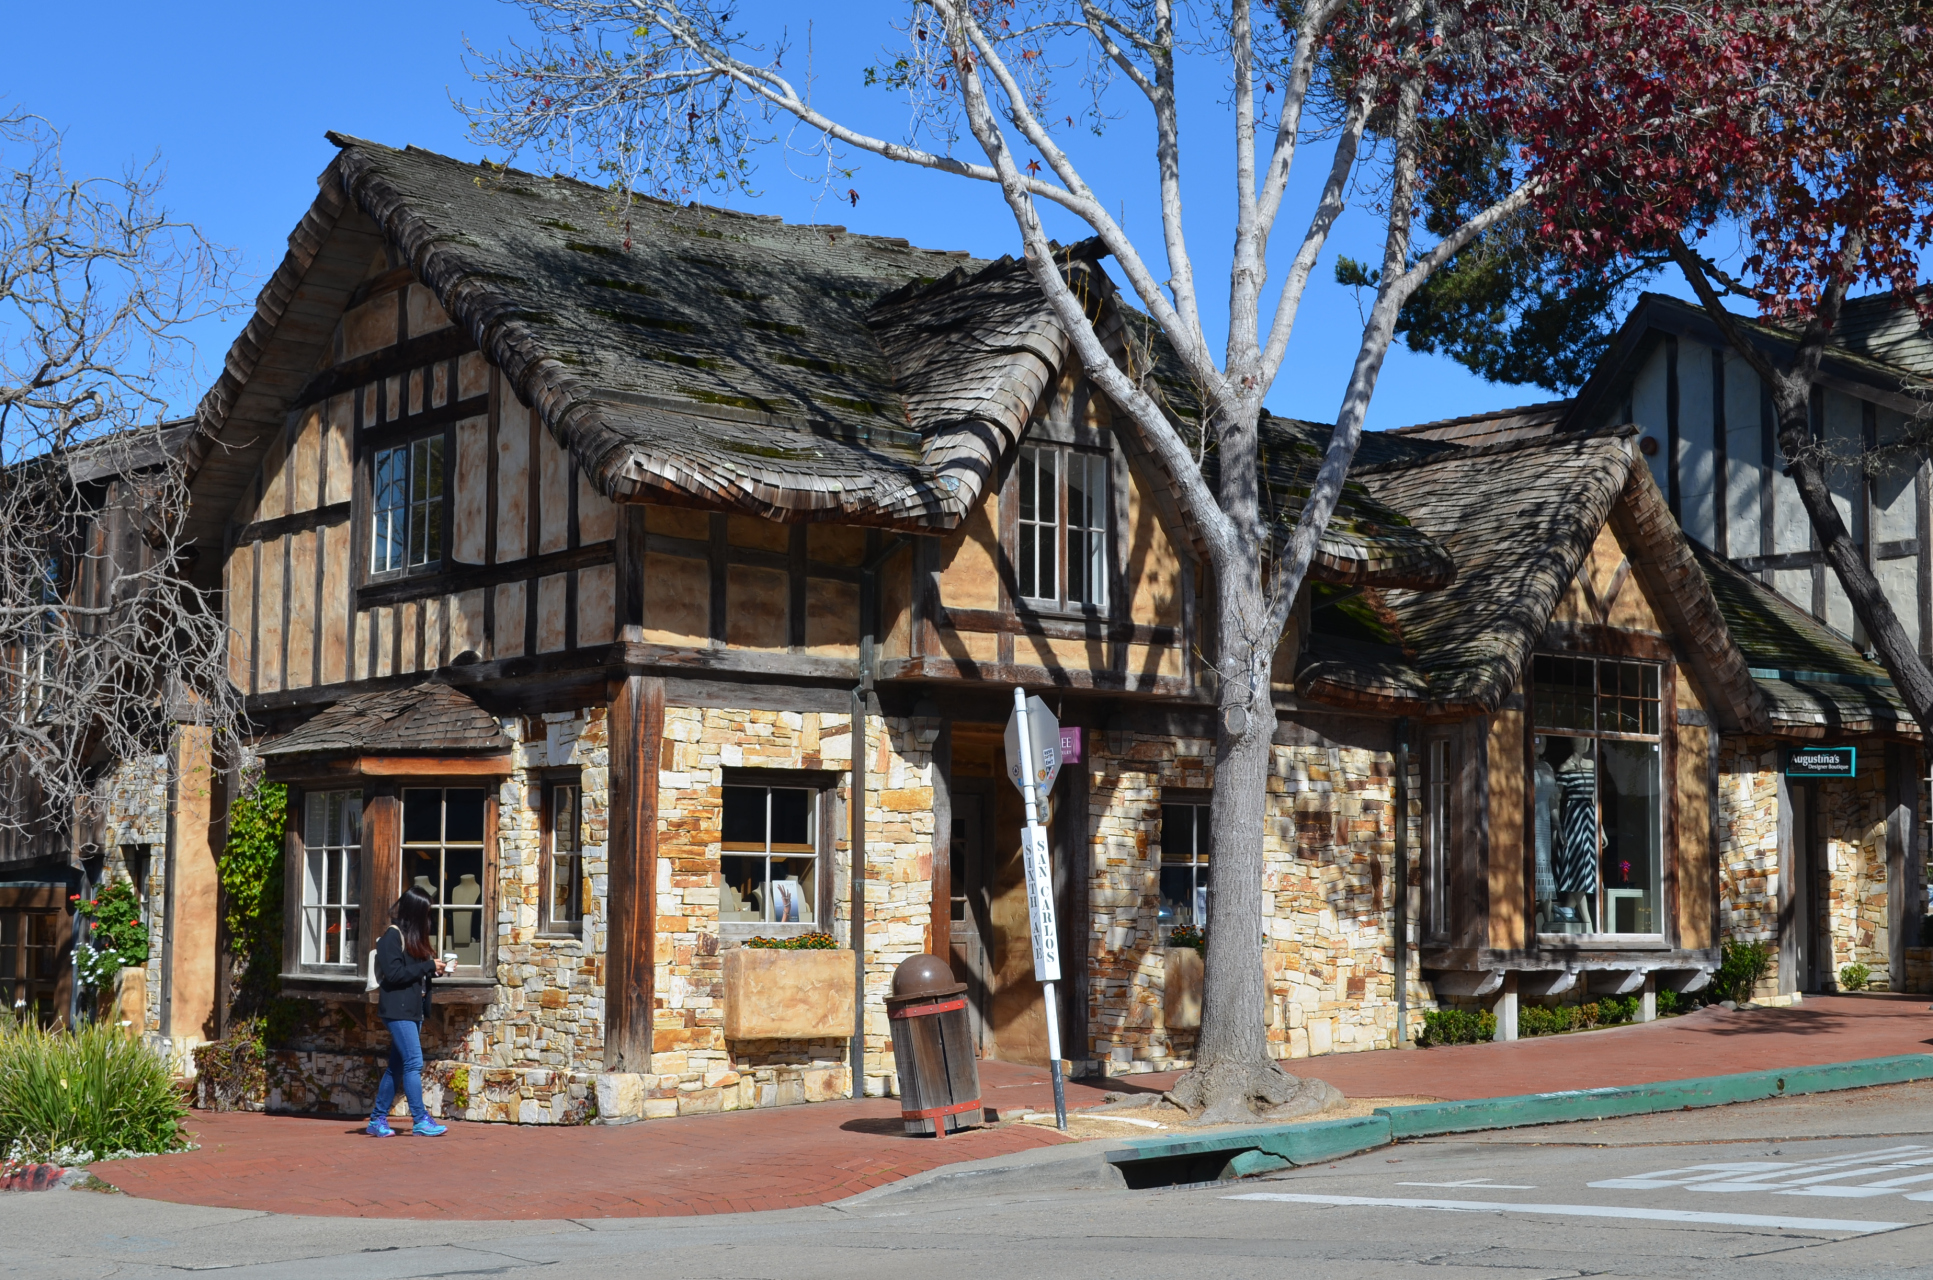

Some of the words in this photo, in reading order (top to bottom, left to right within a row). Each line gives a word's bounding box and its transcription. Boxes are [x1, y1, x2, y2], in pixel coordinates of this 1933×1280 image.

[1037, 840, 1047, 877] SAN
[1025, 844, 1038, 908] SIXTH
[1033, 921, 1043, 960] AVE
[1040, 886, 1055, 963] CARLOS
